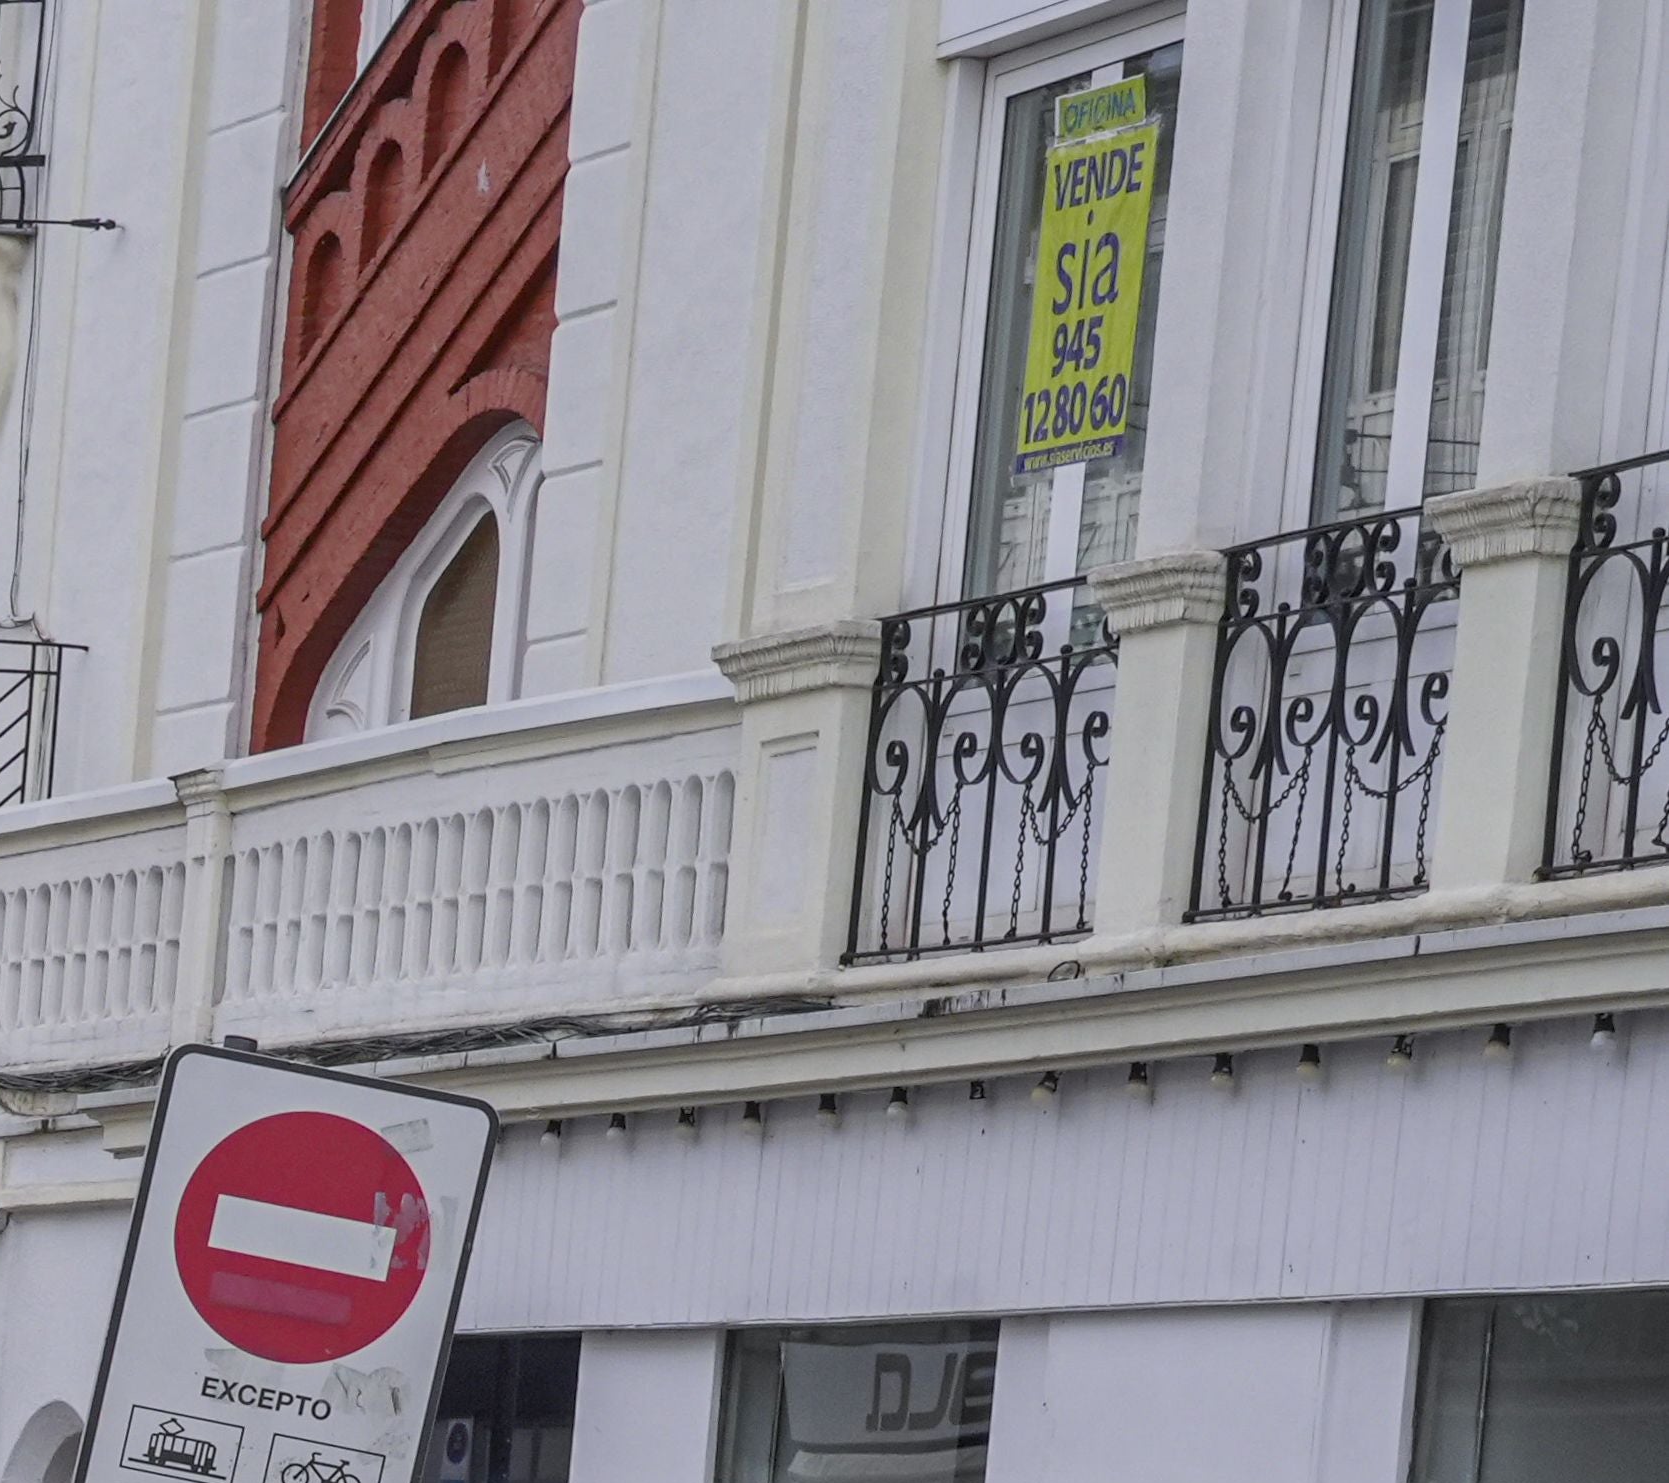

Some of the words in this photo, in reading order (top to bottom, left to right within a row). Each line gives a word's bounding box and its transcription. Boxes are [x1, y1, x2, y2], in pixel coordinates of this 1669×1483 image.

[1064, 86, 1137, 134] OFICINA
[1054, 141, 1145, 212] VENDE
[1052, 208, 1120, 315] sia
[1051, 315, 1105, 378] 945
[200, 1376, 332, 1421] EXCEPTO
